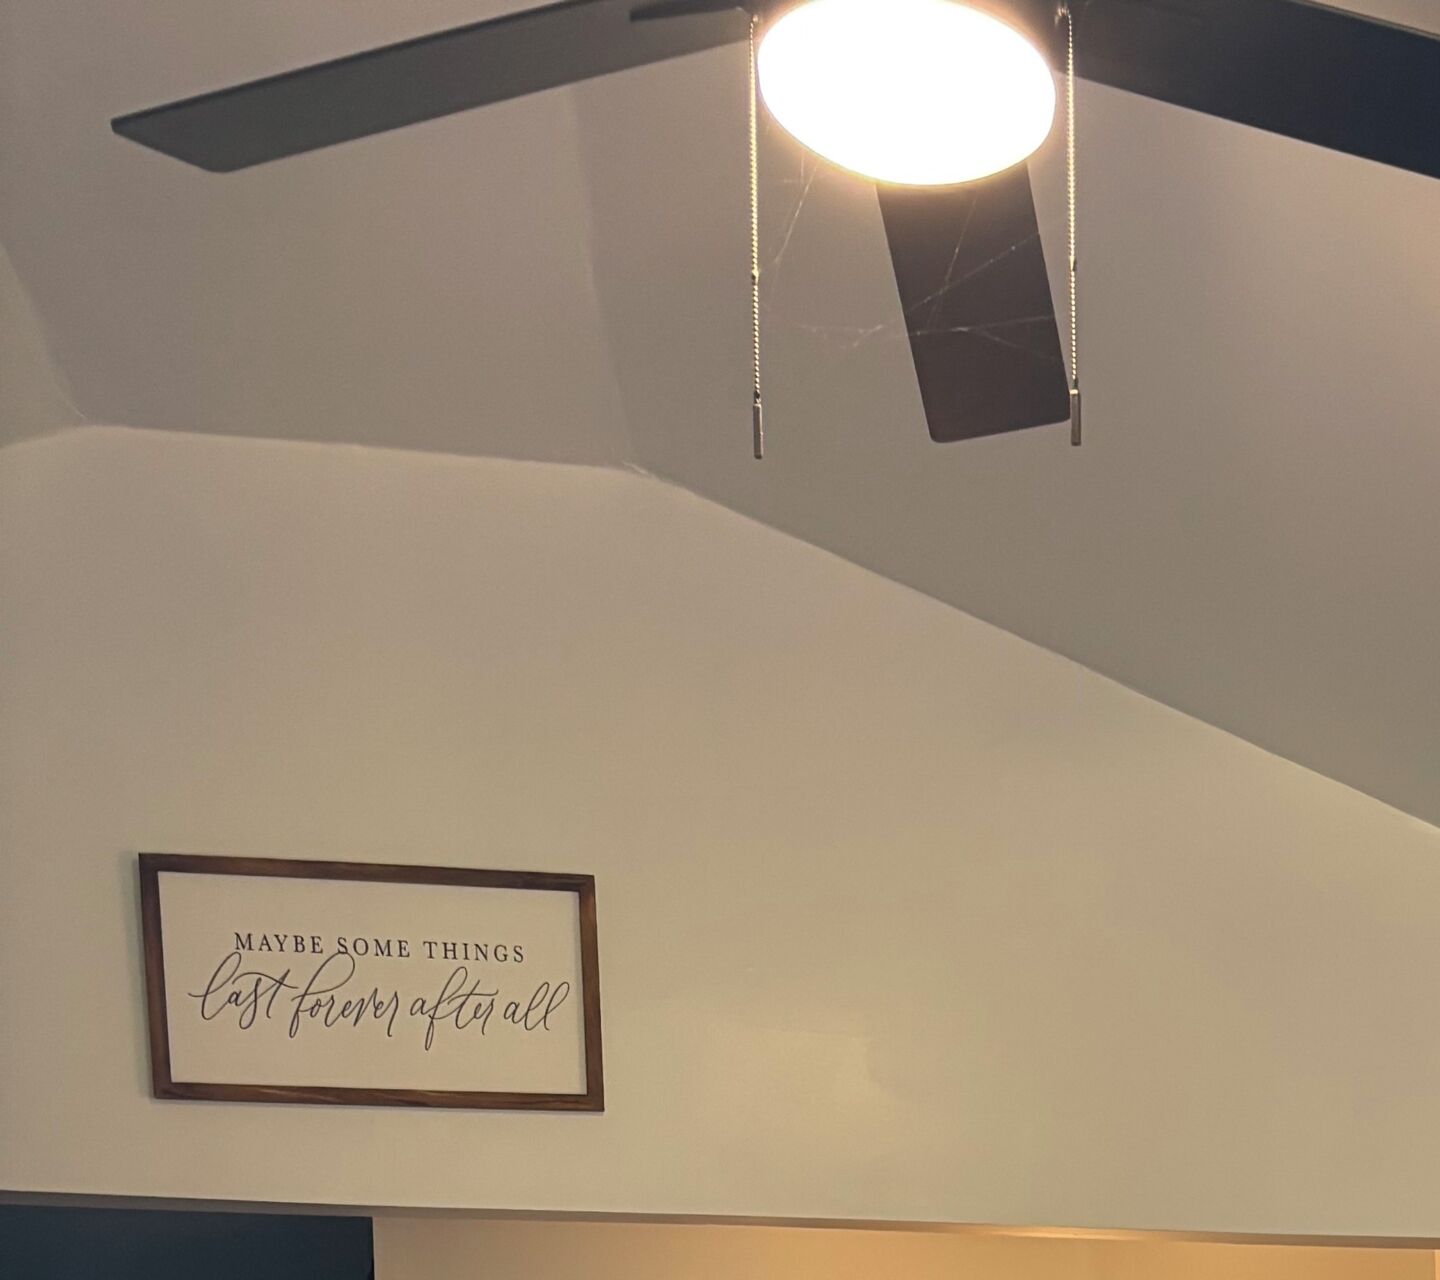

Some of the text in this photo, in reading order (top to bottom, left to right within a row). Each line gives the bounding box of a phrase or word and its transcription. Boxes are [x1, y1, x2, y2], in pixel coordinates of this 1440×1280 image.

[234, 932, 525, 963] MAYBE SOME THINGS
[188, 951, 570, 1051] last forever after all
